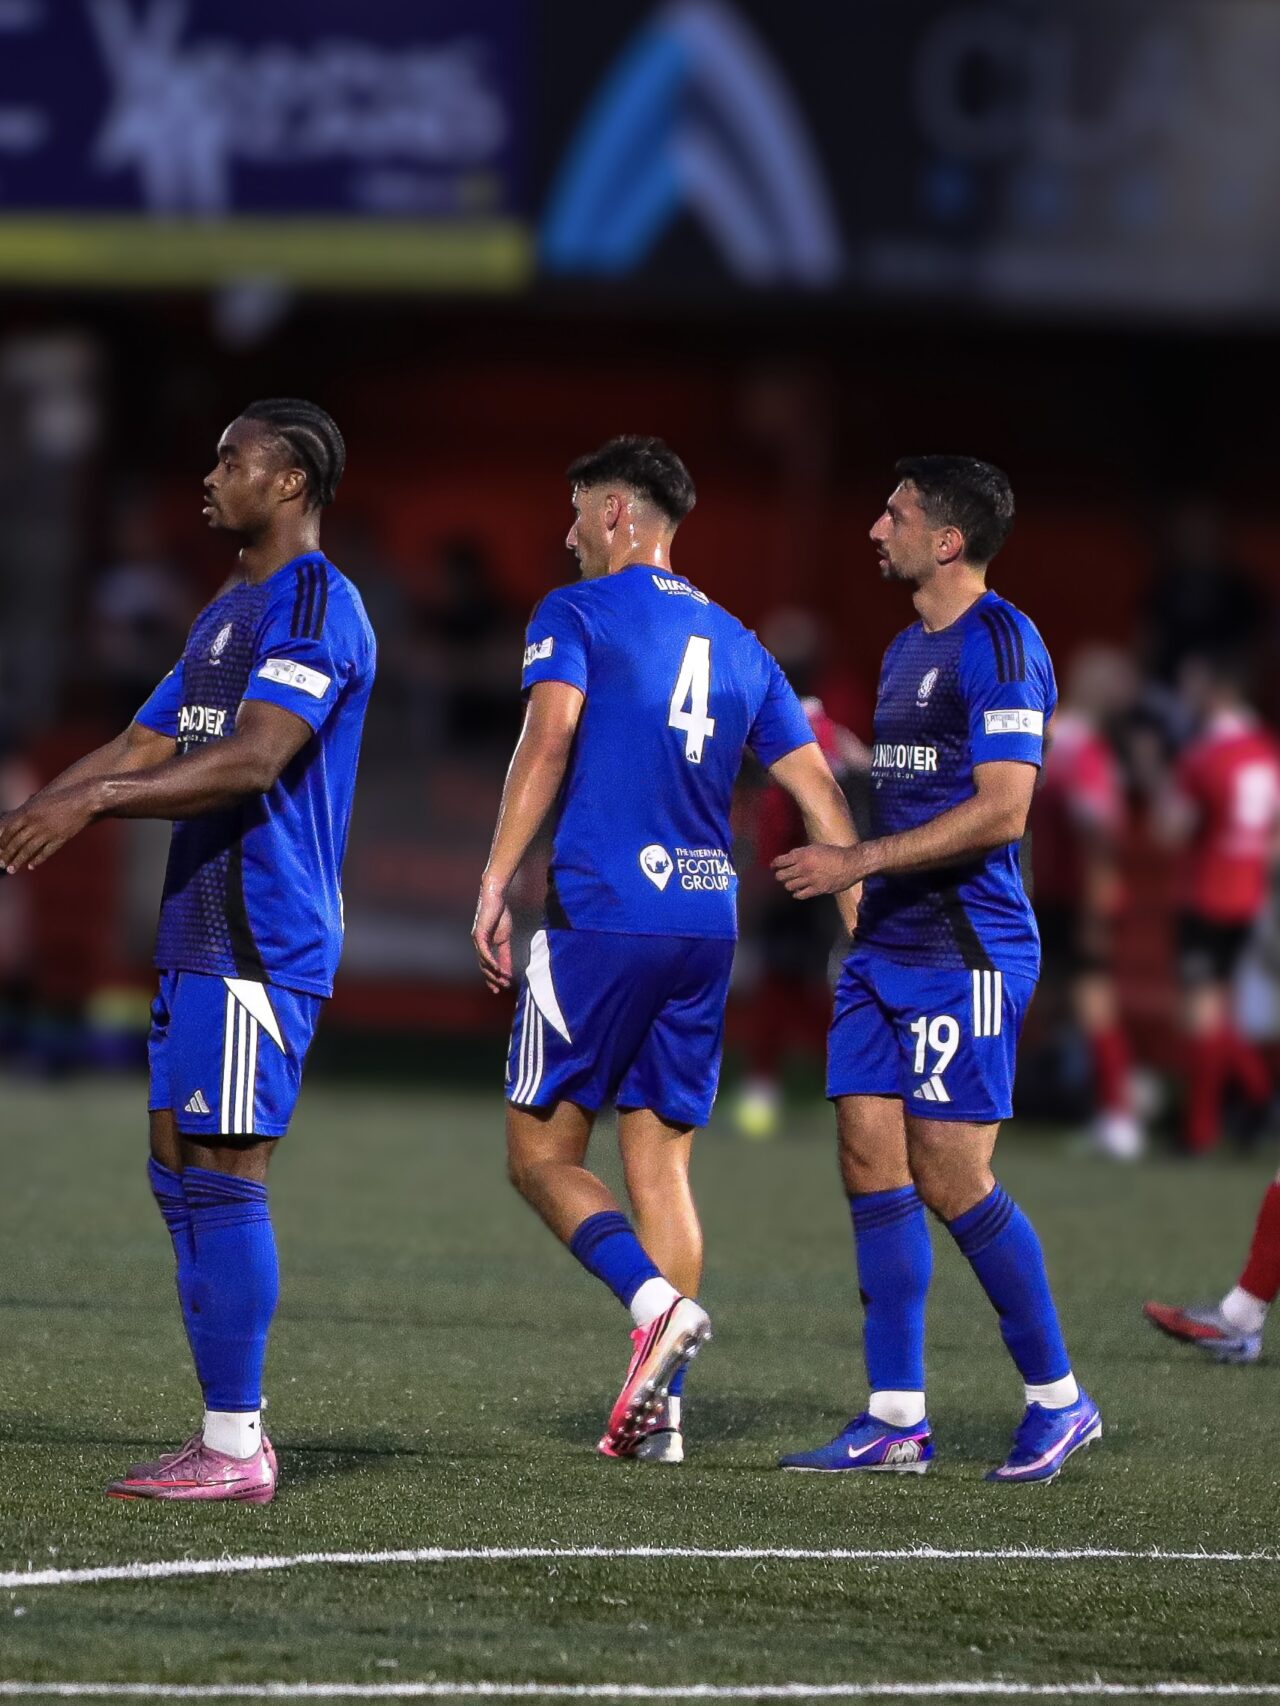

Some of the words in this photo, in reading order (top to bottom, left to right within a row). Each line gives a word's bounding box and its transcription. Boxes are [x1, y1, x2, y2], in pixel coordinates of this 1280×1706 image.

[668, 635, 715, 764] 4
[681, 875, 729, 891] GROUP
[910, 1015, 961, 1074] 19
